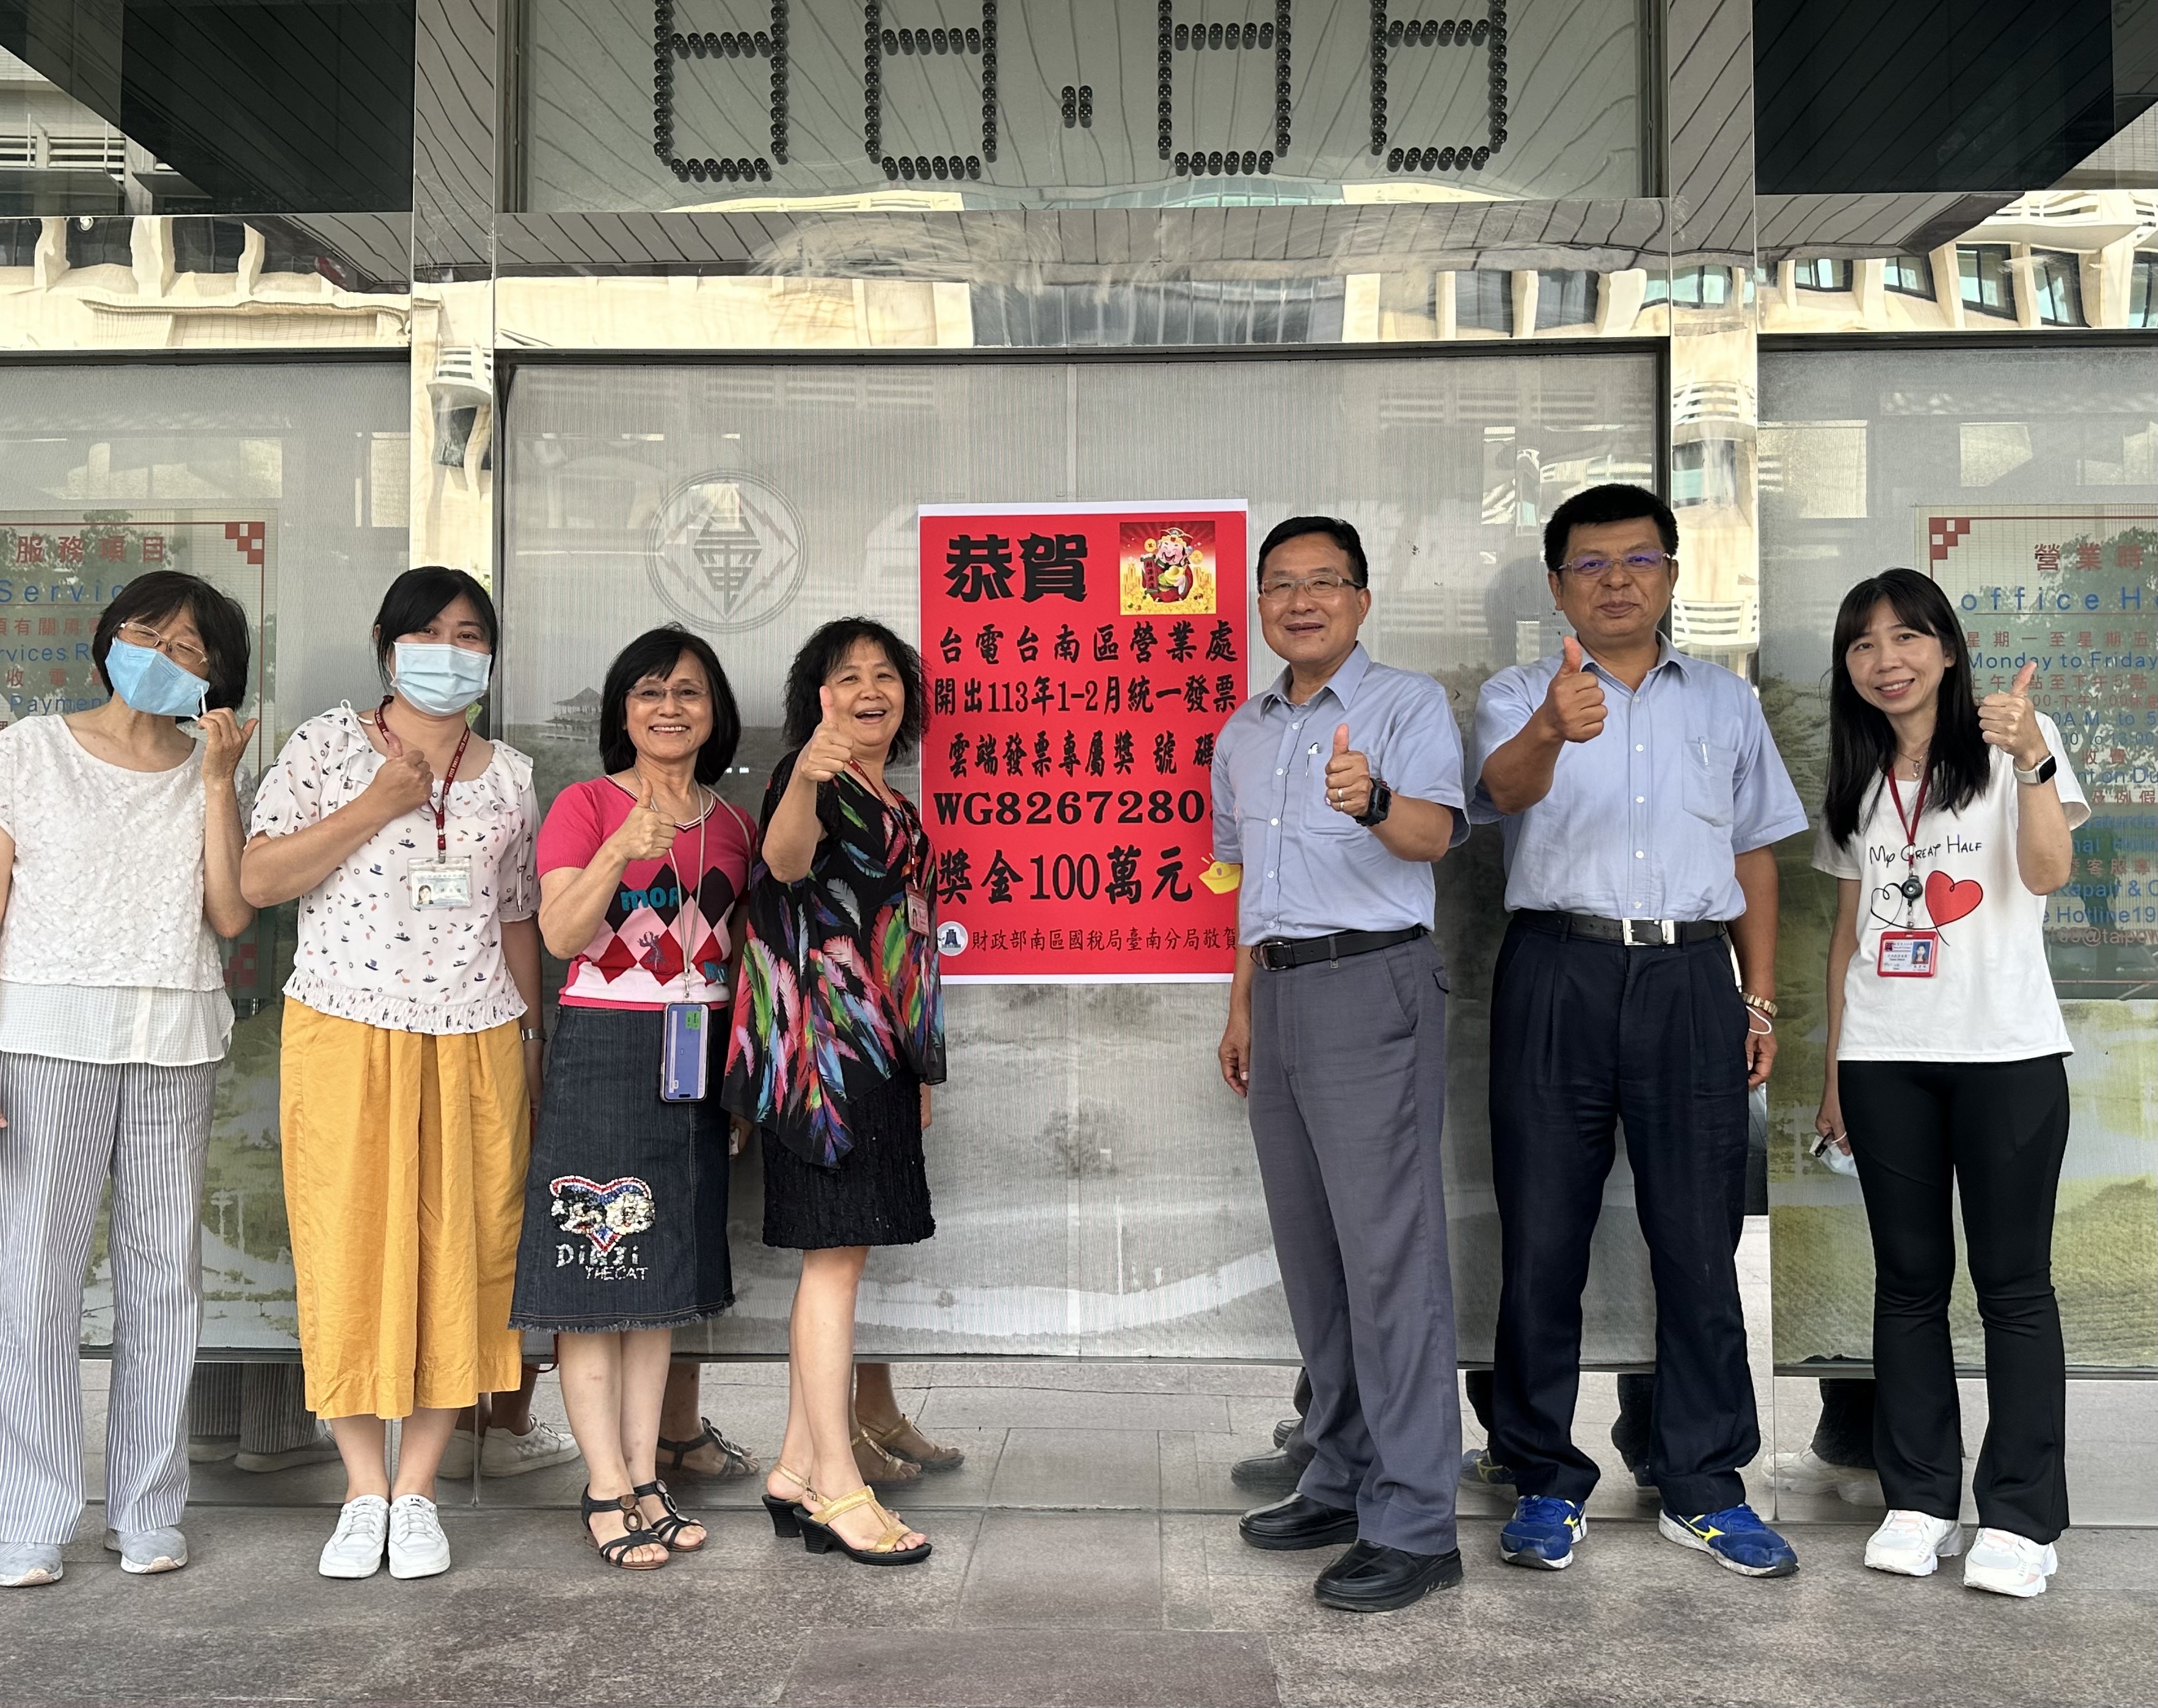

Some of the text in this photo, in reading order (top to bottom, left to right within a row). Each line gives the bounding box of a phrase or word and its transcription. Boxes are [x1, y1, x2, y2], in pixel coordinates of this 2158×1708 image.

[16, 536, 164, 562] 服務項目
[945, 532, 1088, 603] 恭賀
[1961, 587, 2099, 611] office
[940, 620, 1238, 664] 台電台南區營業處
[1967, 631, 2148, 647] 星期一至星期五
[1970, 652, 2158, 672] Monday to Friday
[10, 695, 110, 715] Paymen
[935, 674, 1236, 714] 開出113年1-2月統一發票
[933, 790, 1213, 824] WG8267280
[938, 844, 1193, 906] 獎金100萬元
